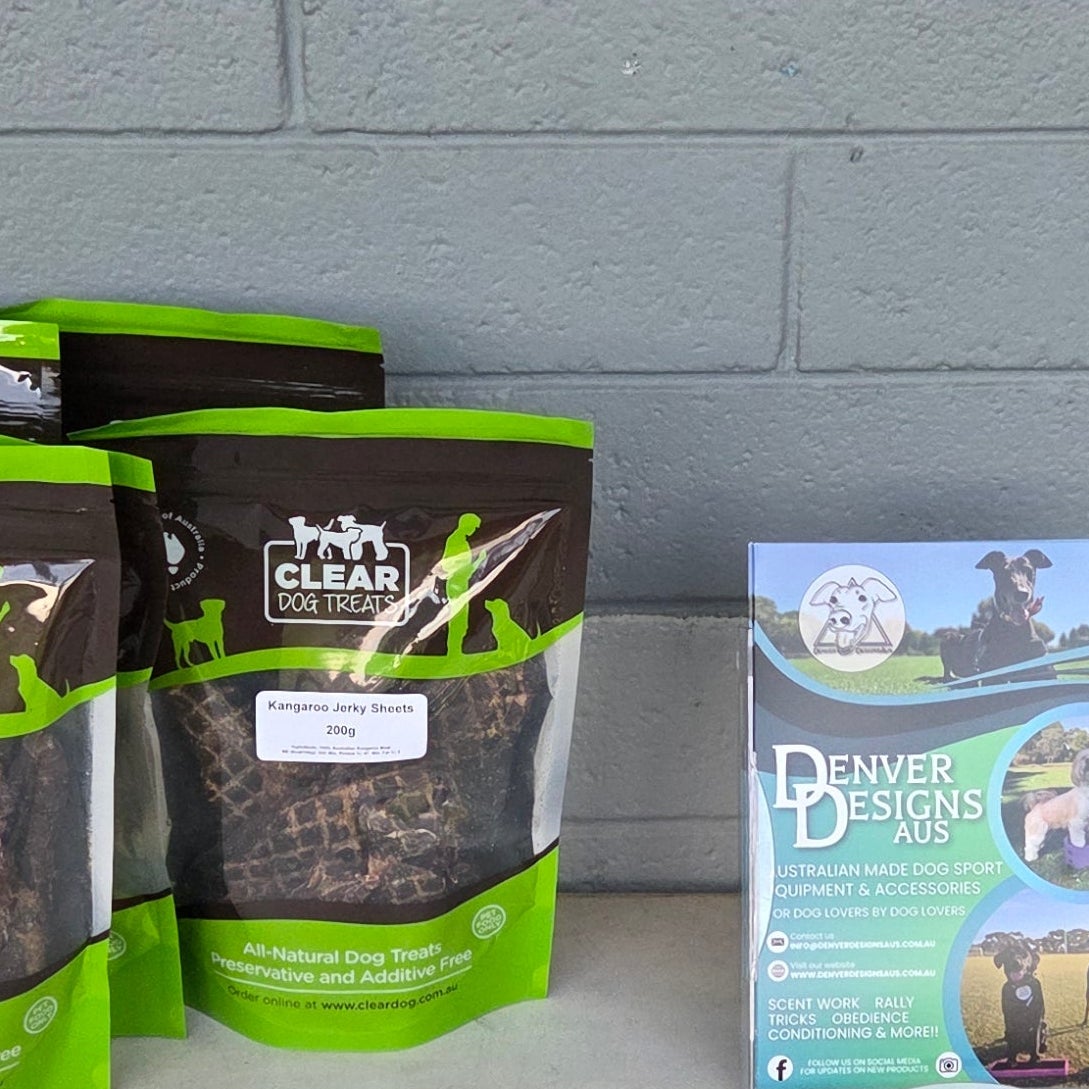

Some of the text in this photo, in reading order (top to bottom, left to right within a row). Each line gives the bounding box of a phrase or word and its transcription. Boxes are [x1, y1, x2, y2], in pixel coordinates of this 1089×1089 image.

[176, 515, 205, 553] Australia
[274, 562, 400, 592] CLEAR
[277, 592, 398, 615] DOG TREATS
[268, 700, 414, 716] Kangaroo Jerky Sheets
[326, 725, 356, 738] 200g
[772, 744, 954, 808] DENVER
[793, 784, 984, 848] DESIGNS
[893, 820, 950, 844] AUS
[775, 861, 1004, 878] USTRALIAN MADE DOG SPORT
[775, 881, 981, 898] QUIPMENT & ACCESSORIES
[773, 906, 966, 919] OR DOG LOVERS BY DOG LOVERS
[243, 941, 442, 966] All-Natural Dog Treats
[211, 949, 472, 984] Preservative and Additive Free
[227, 983, 458, 1010] Order online at www.cleardog.com.au
[768, 996, 915, 1011] SCENT WORK RALLY
[768, 1012, 909, 1026] TRICKS OBEDIENCE
[768, 1026, 939, 1041] CONDITIONING & MORE!!
[0, 1045, 22, 1062] ee
[800, 1065, 929, 1076] FOR UPDATES ON NEW PRODUCTS
[808, 1058, 840, 1067] FOLLOW
[840, 1058, 852, 1066] US
[853, 1058, 866, 1066] ON
[867, 1058, 895, 1066] SOCIAL
